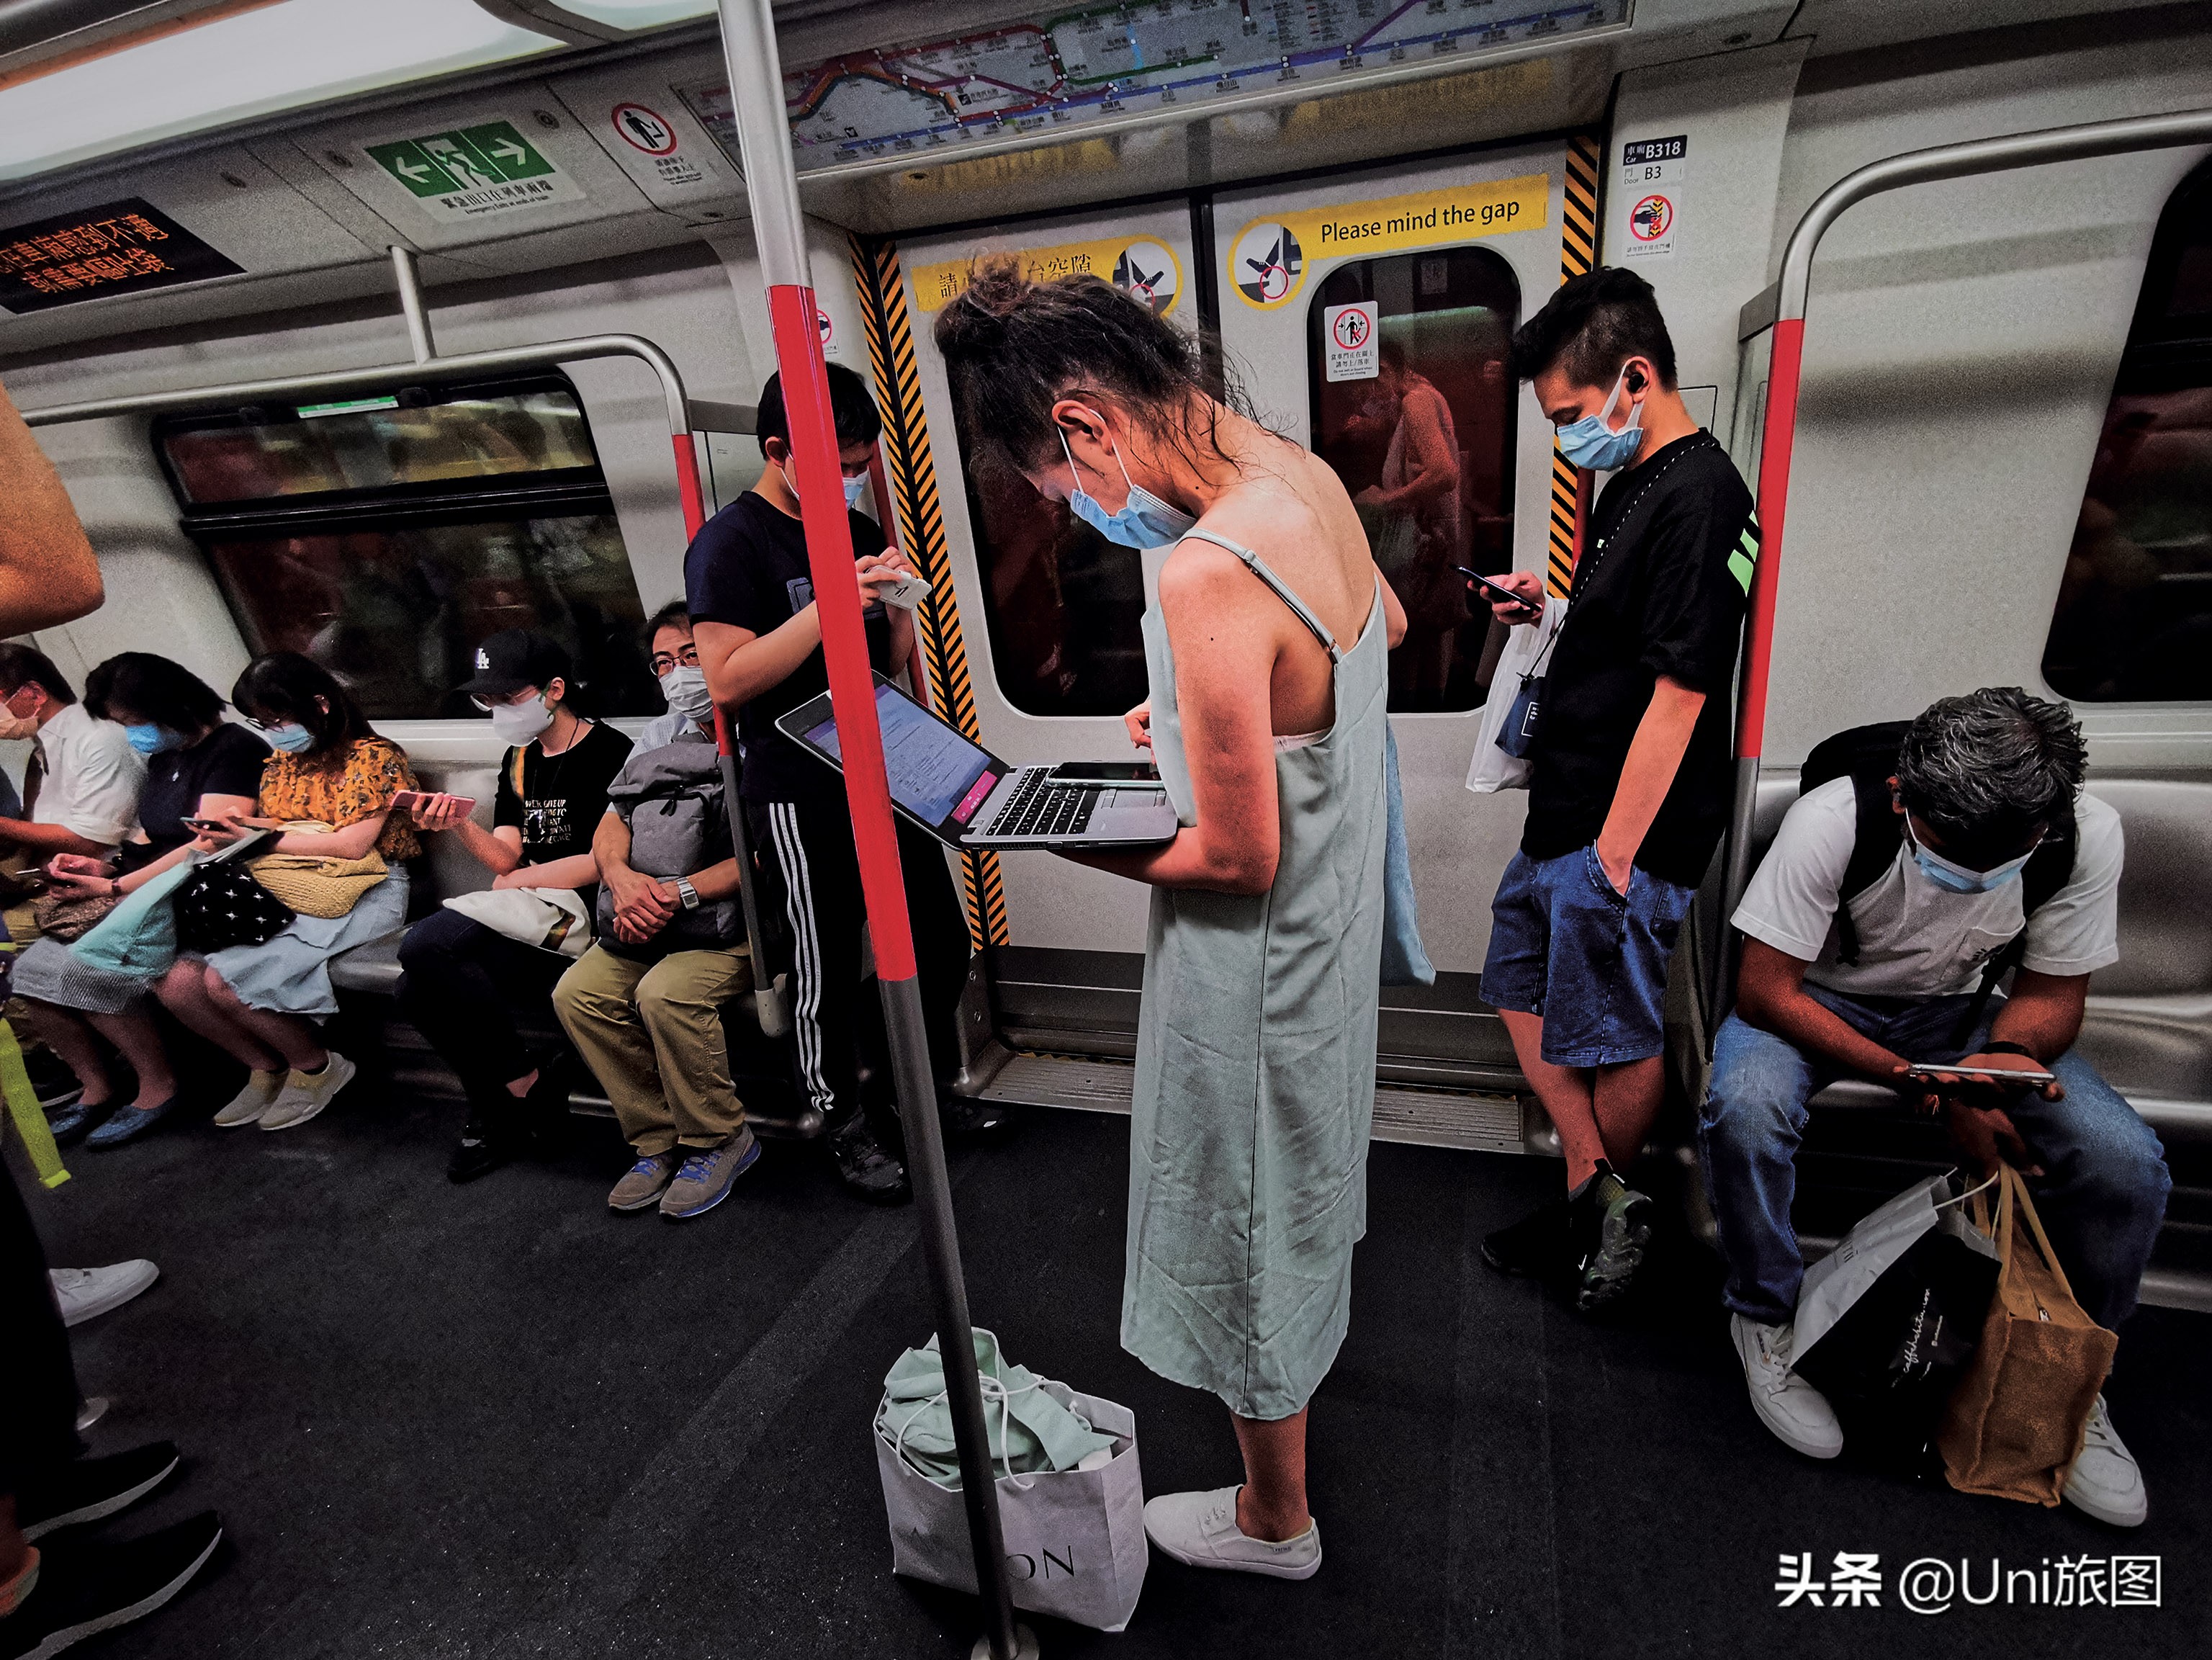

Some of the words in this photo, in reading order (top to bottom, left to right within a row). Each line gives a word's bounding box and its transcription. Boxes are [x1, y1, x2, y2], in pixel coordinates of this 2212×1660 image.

[1645, 141, 1681, 159] B318
[1645, 166, 1661, 180] B3
[1321, 222, 1381, 243] Please
[1387, 207, 1437, 234] mind
[1442, 204, 1475, 225] the
[1480, 200, 1520, 225] gap
